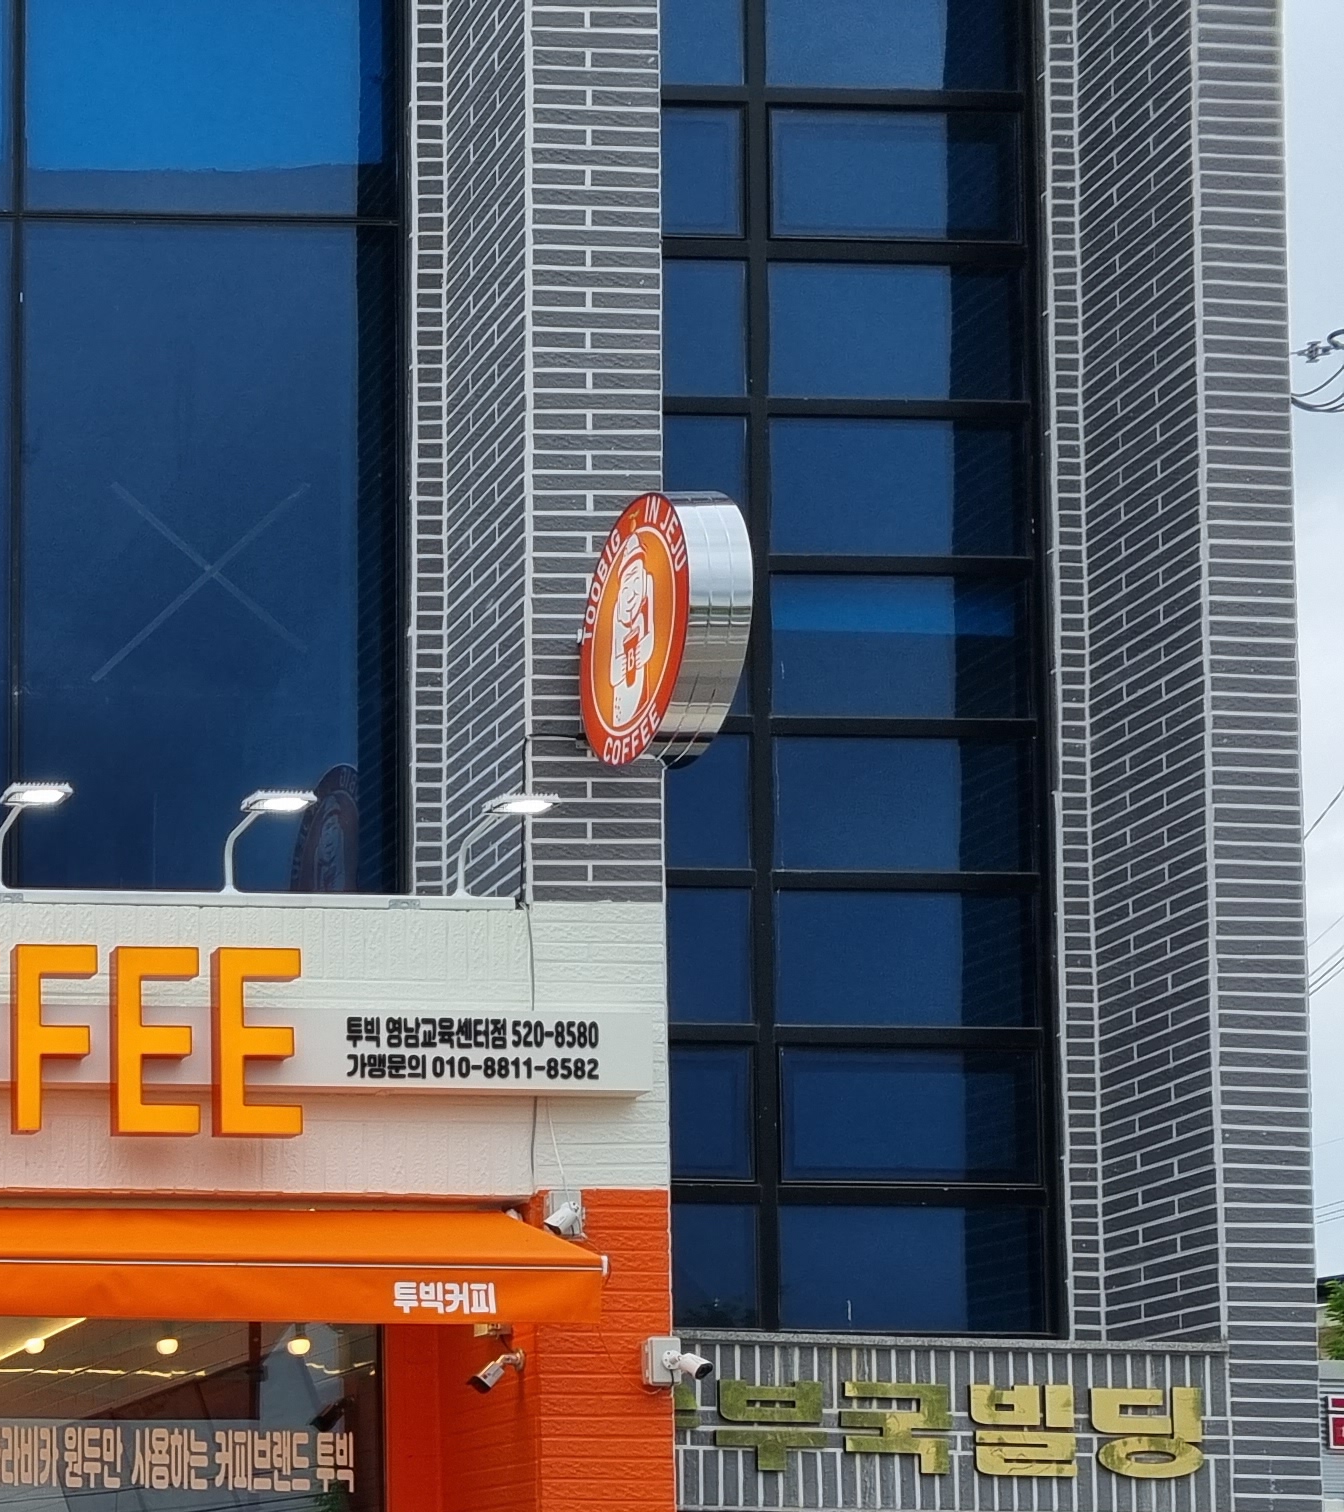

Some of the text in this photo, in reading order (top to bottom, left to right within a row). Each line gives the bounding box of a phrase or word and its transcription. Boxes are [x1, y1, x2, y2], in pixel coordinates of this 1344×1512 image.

[581, 496, 687, 645] TOOBIG IN JEJU
[603, 703, 660, 765] COFFEE
[346, 1016, 600, 1049] 투빅 영남교육센터점 520-8580
[346, 1053, 600, 1080] 가맹문의 010-8811-8582
[392, 1280, 499, 1316] 투빅커피
[64, 1426, 123, 1489] 원두만
[132, 1427, 208, 1490] 사용하는
[214, 1429, 310, 1492] 커피브랜드
[316, 1431, 355, 1493] 투빅
[673, 1379, 1205, 1480] 부국빌딩
